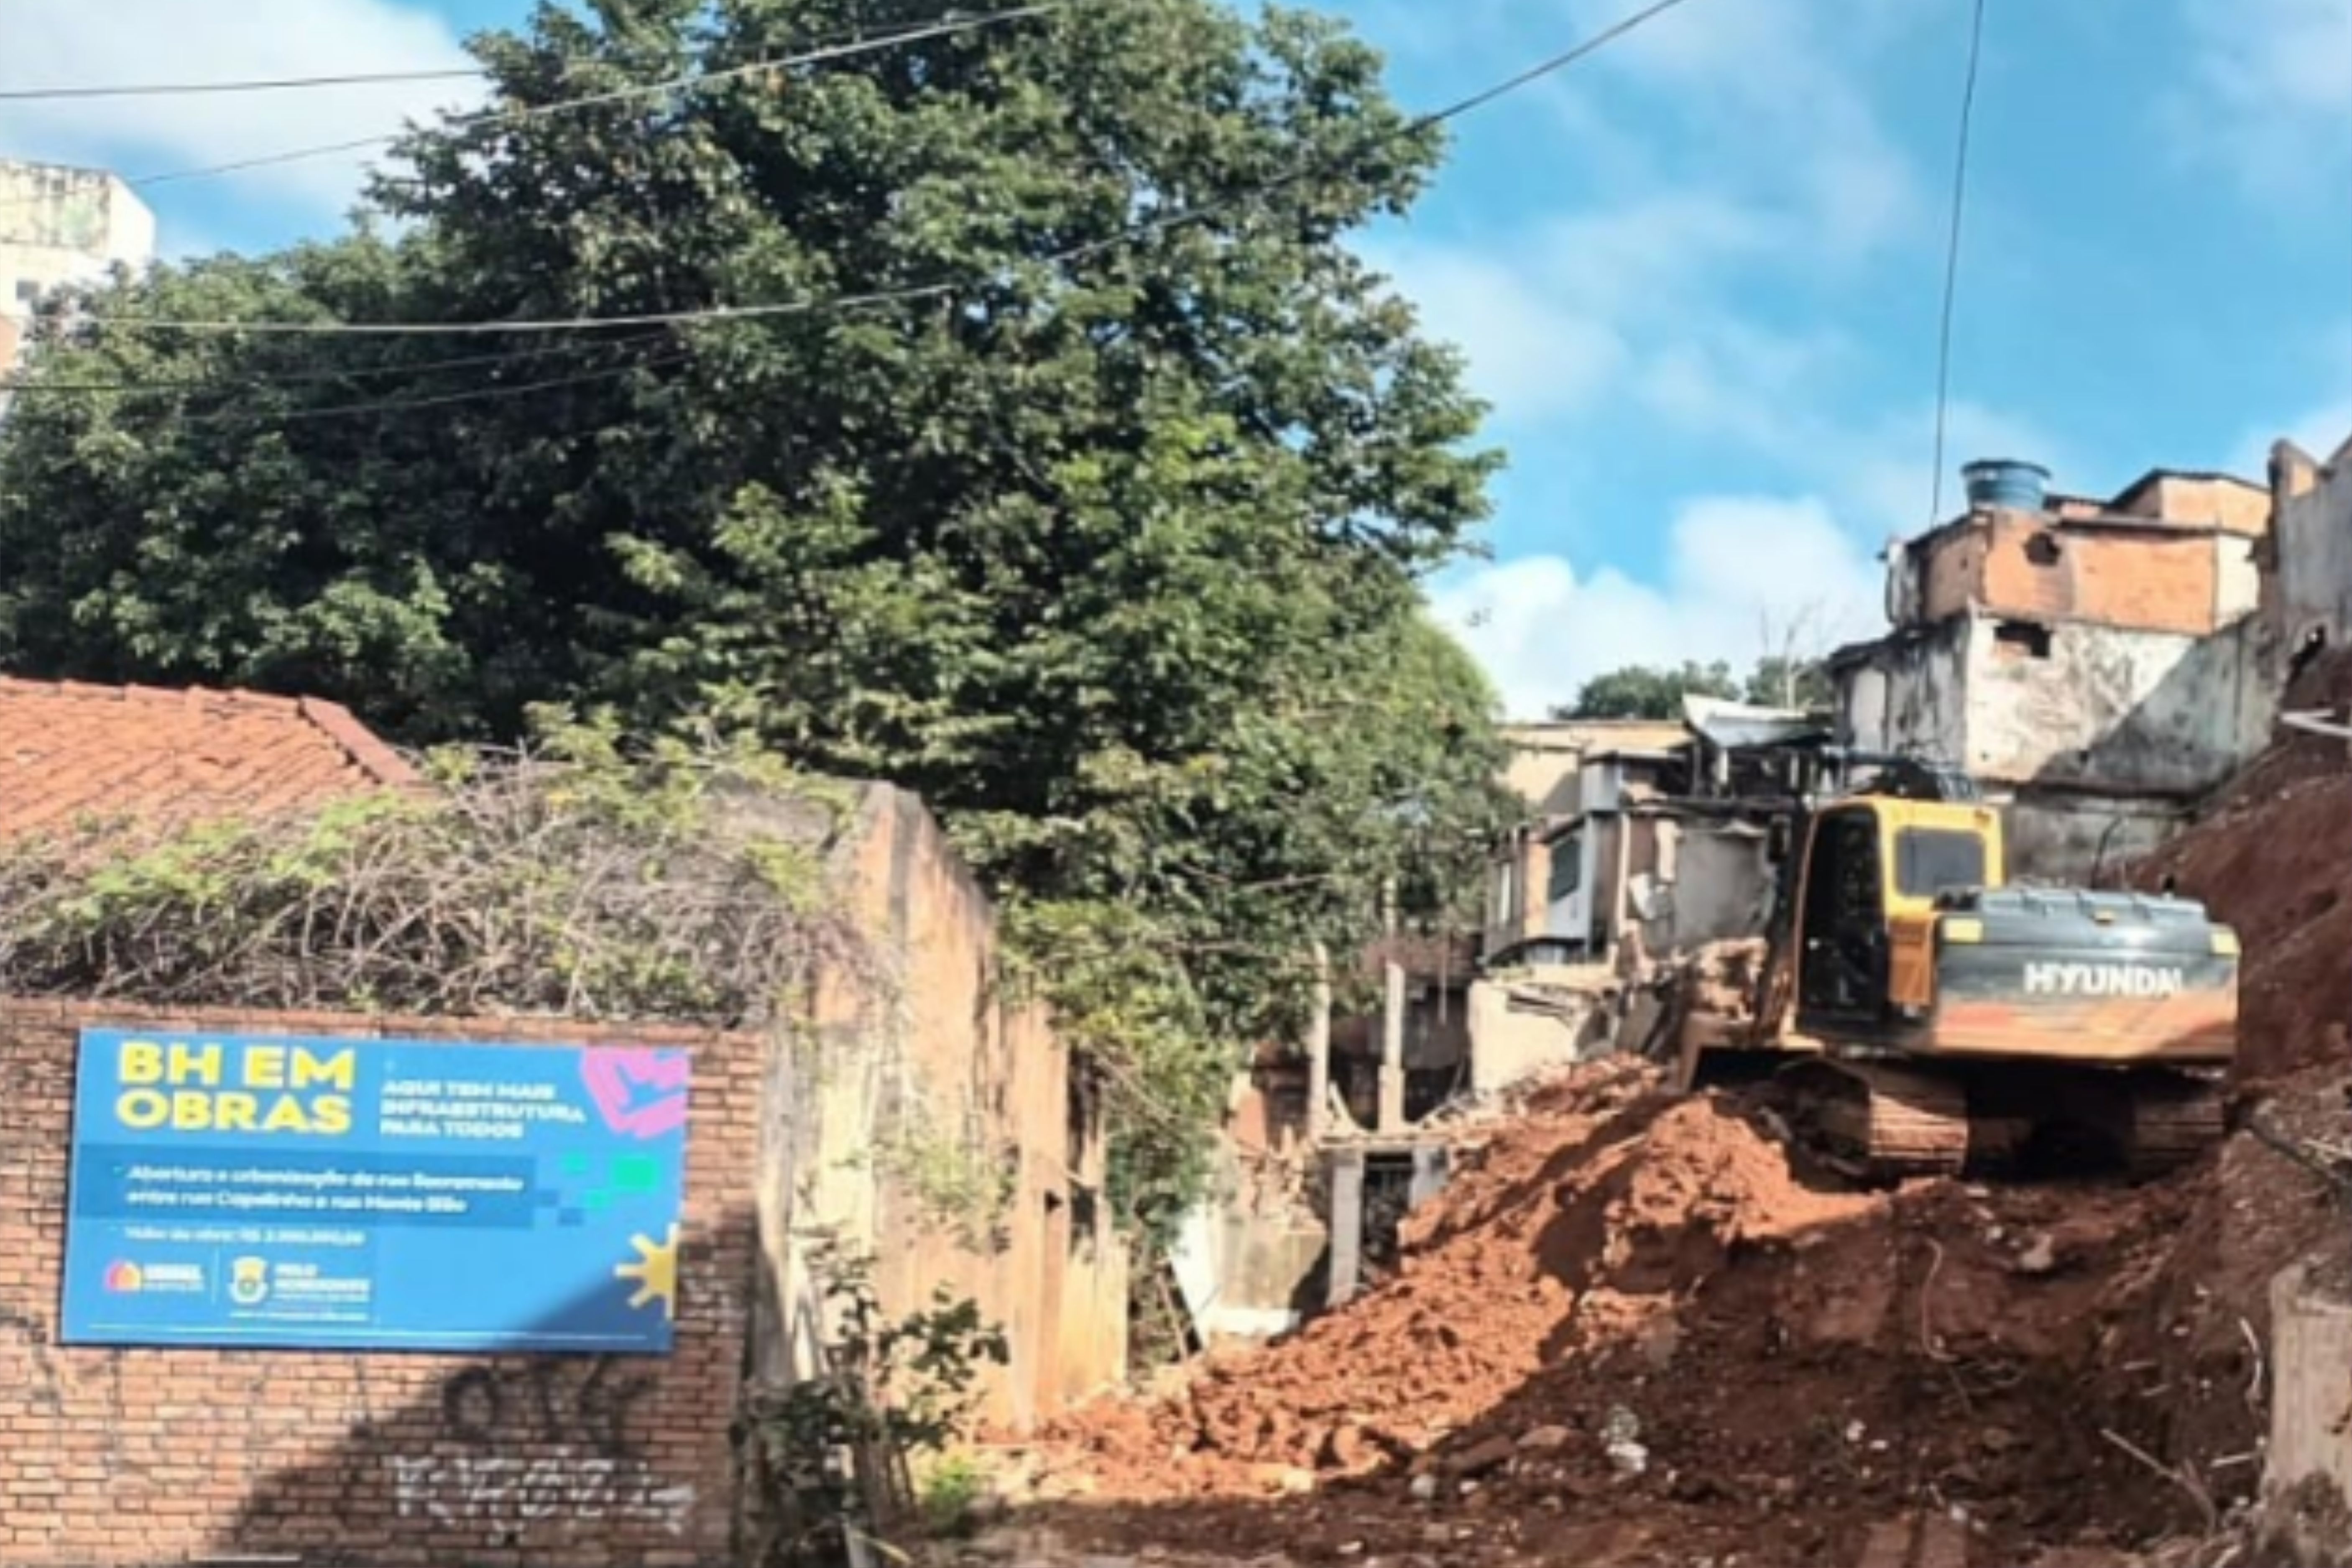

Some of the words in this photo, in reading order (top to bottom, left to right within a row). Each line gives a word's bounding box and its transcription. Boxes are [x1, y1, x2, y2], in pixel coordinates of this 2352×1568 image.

[119, 1041, 222, 1086] BH
[244, 1045, 355, 1090] EM
[116, 1088, 352, 1134] OBRAS
[382, 1079, 441, 1097] AQUI
[447, 1081, 495, 1099] TEM
